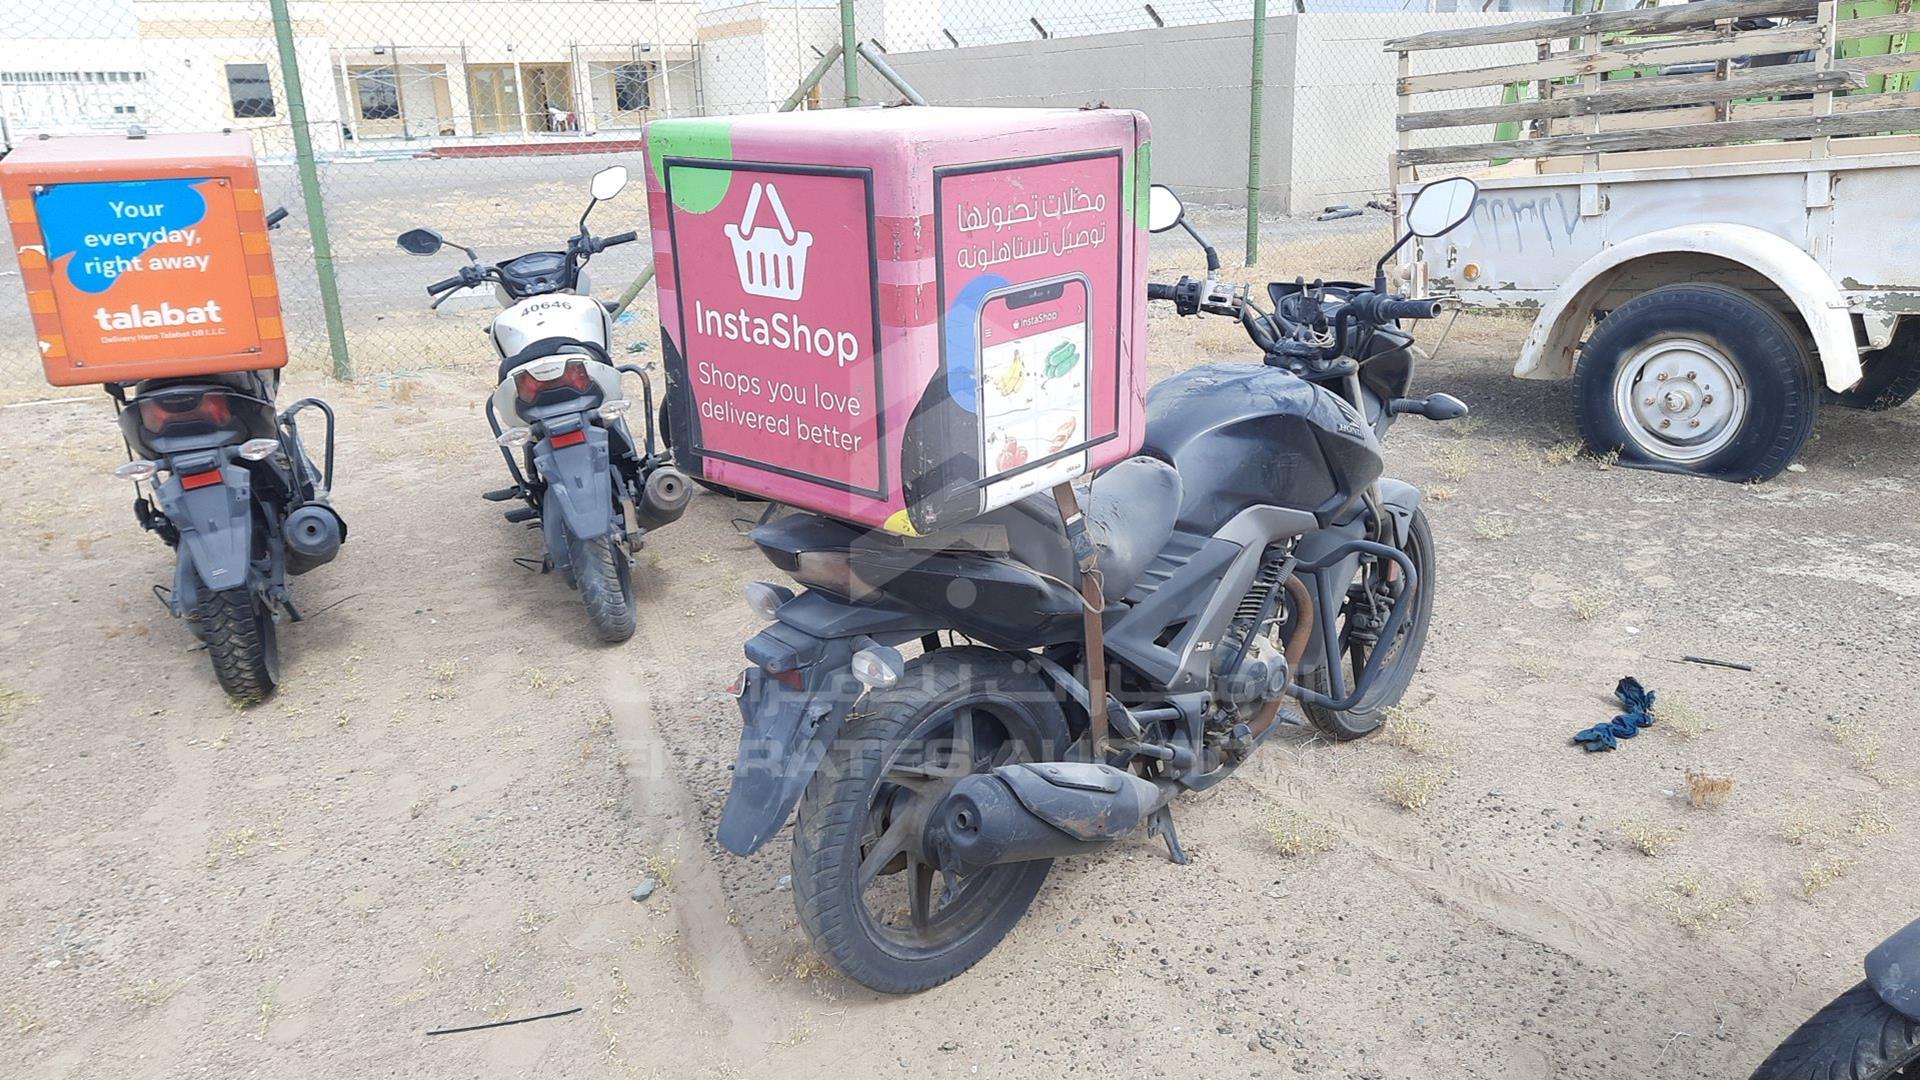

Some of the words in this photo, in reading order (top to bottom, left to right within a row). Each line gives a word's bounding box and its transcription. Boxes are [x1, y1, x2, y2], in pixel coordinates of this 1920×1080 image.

[108, 201, 164, 219] Your
[84, 226, 202, 249] everyday,
[84, 255, 143, 278] right
[148, 255, 209, 273] away
[93, 299, 223, 331] talabat
[521, 301, 572, 316] 40646
[695, 300, 859, 367] InstaShop
[698, 361, 761, 396] Shops
[767, 380, 807, 406] you
[814, 383, 861, 416] love
[701, 397, 790, 437] delivered
[797, 416, 862, 452] better
